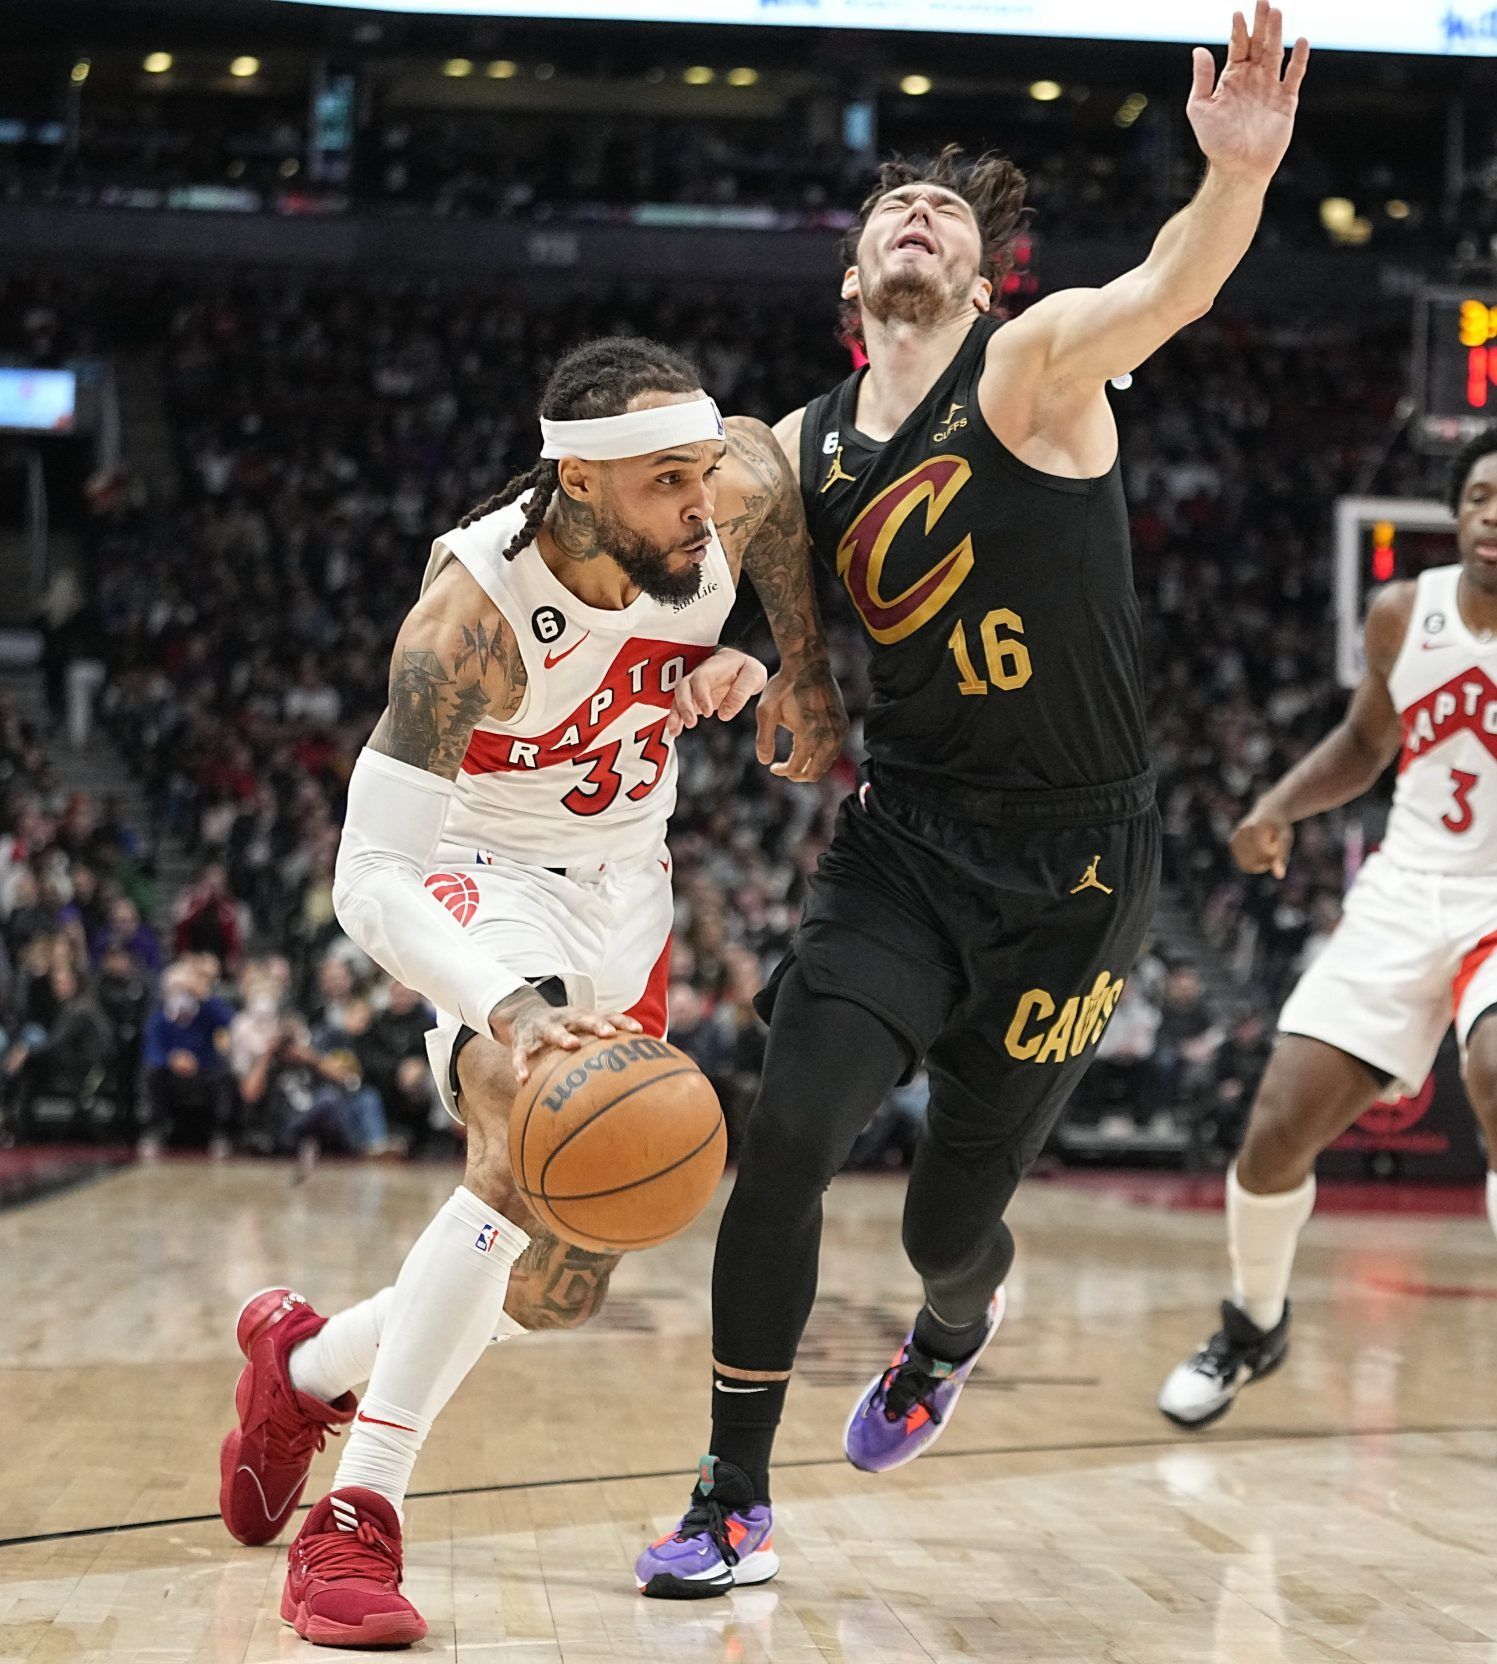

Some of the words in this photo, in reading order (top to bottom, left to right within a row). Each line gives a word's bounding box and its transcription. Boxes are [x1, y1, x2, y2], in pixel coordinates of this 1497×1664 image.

[822, 431, 839, 455] 6
[836, 454, 974, 645] C
[536, 610, 558, 640] 6
[696, 582, 718, 600] Life
[948, 607, 1033, 696] 16
[508, 656, 685, 768] RAPTO
[1407, 682, 1497, 753] APTO
[560, 714, 670, 817] 33
[1441, 768, 1479, 834] 3
[1004, 970, 1124, 1063] CAVS
[541, 1038, 680, 1113] Wilson
